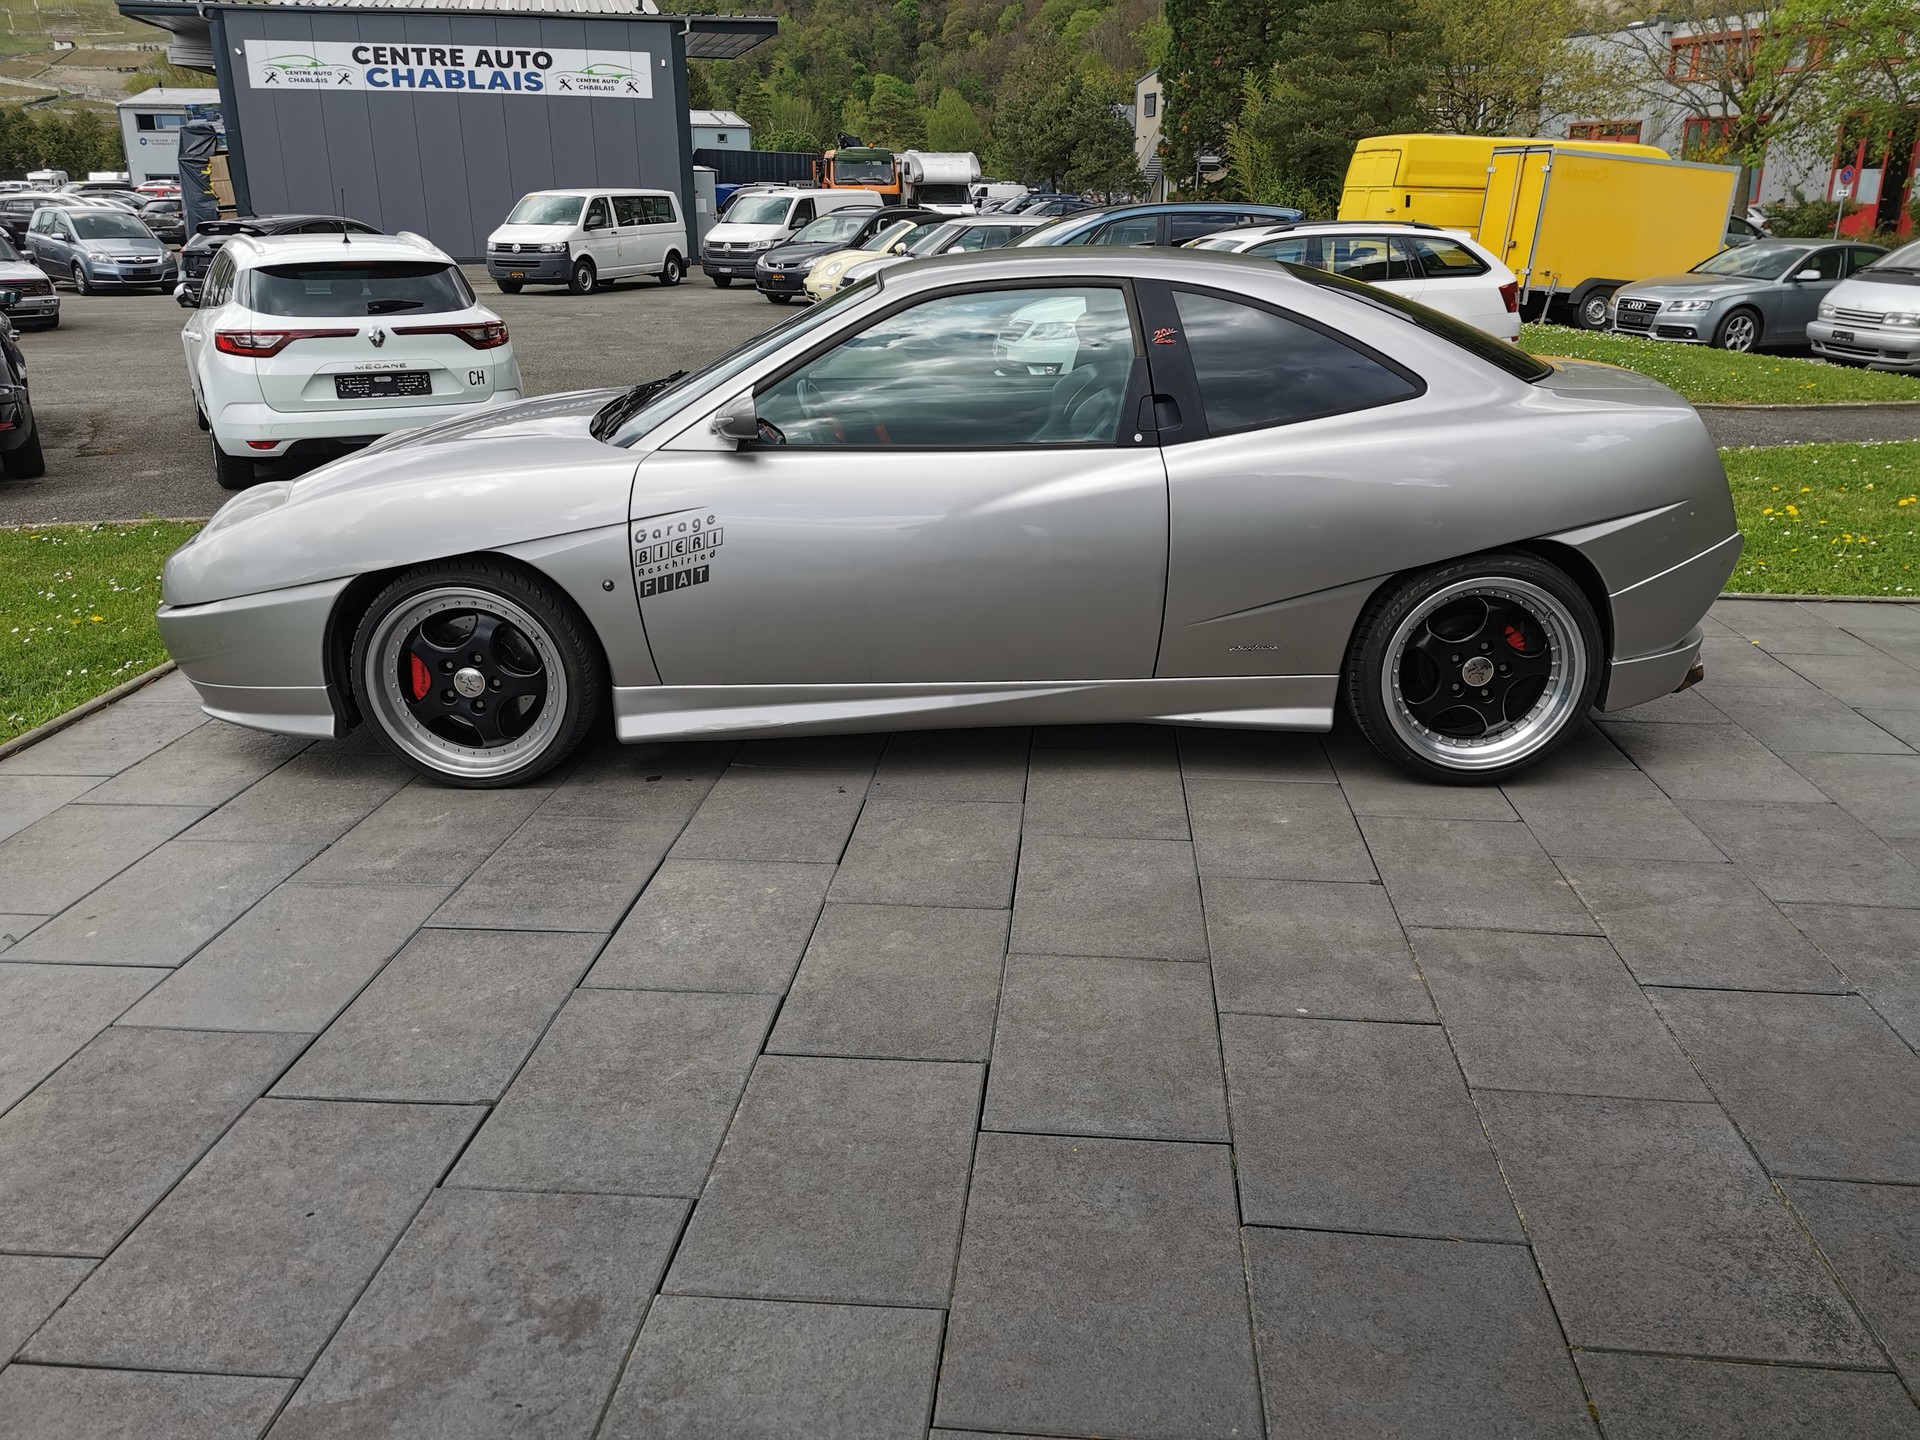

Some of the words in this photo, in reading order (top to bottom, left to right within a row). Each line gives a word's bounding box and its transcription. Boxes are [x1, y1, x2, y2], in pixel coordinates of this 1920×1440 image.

[351, 45, 465, 67] CENTRE
[474, 49, 553, 69] AUTO
[366, 67, 544, 92] CHABLAIS
[354, 362, 408, 371] MEGANE
[468, 370, 485, 386] CH
[634, 514, 716, 543] Garage
[638, 530, 718, 564] BIERI
[642, 566, 707, 596] FIAT
